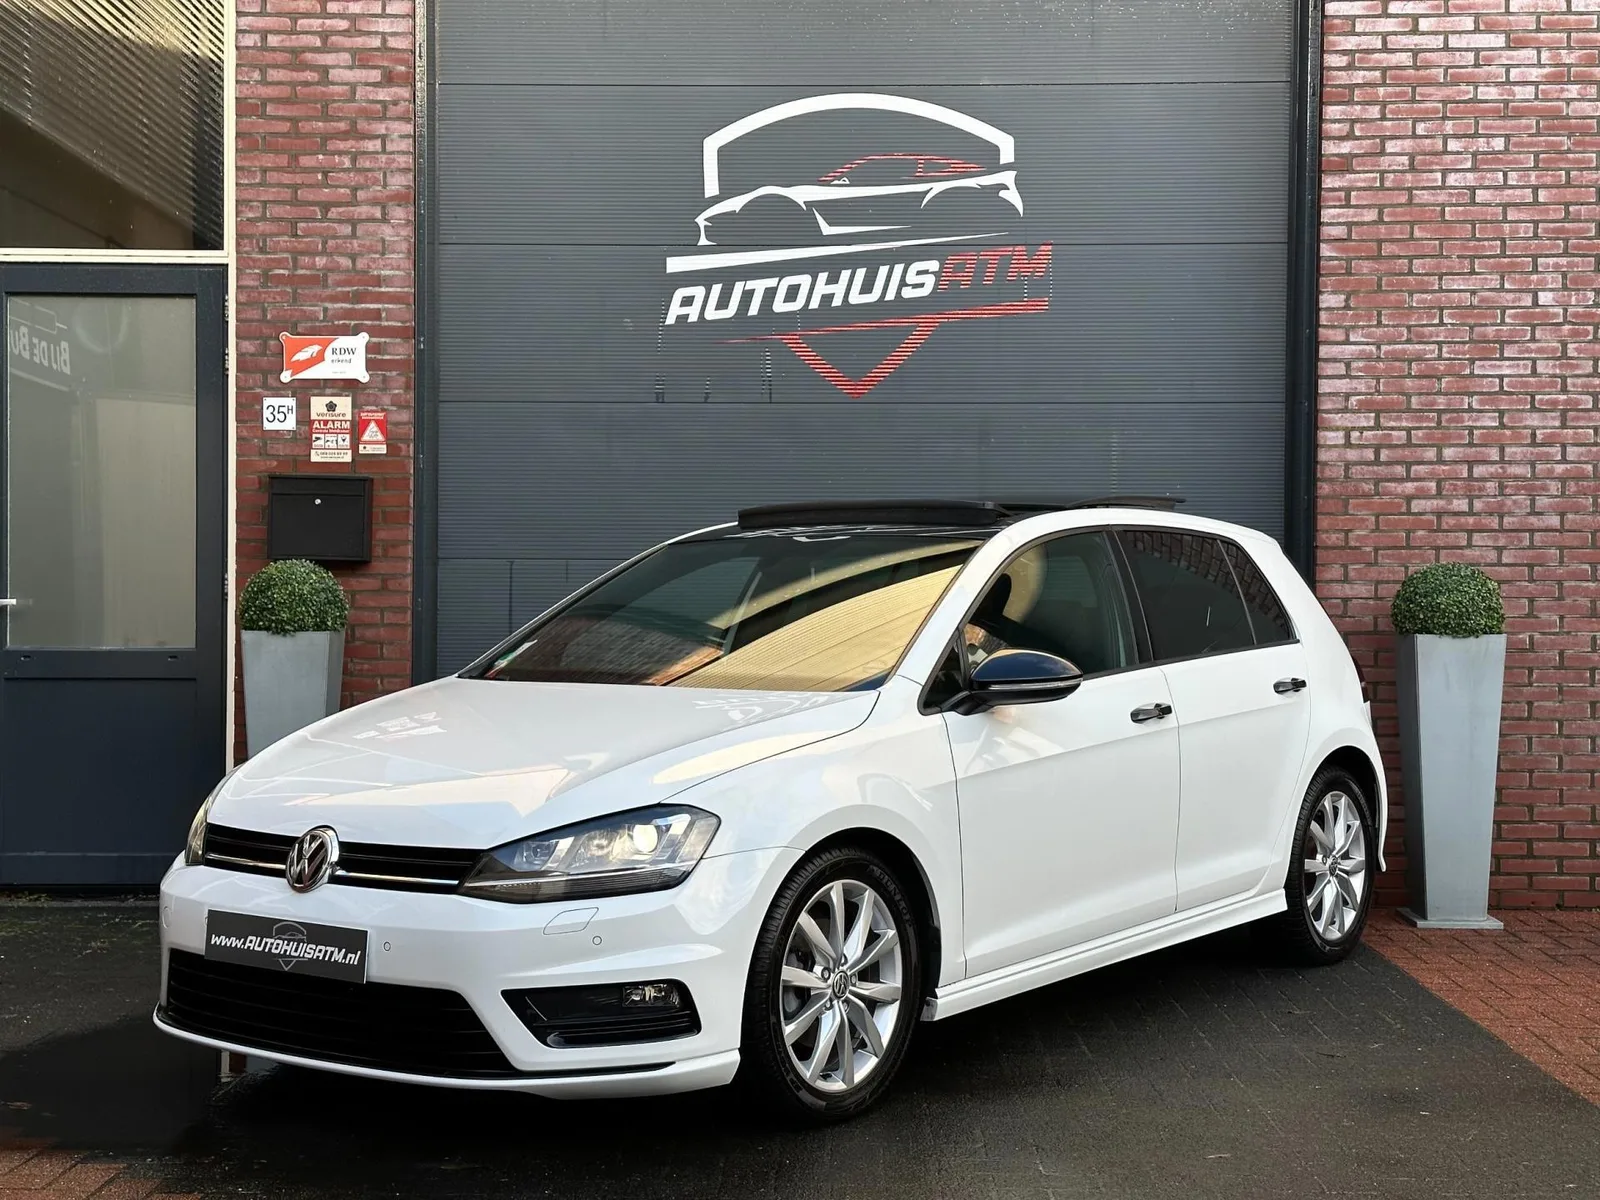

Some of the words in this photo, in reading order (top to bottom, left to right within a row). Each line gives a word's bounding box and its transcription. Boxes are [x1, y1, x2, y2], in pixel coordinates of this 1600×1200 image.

[331, 347, 357, 356] RDW
[313, 420, 350, 429] ALARM
[210, 933, 361, 965] www.AUTOHUISATM.nl
